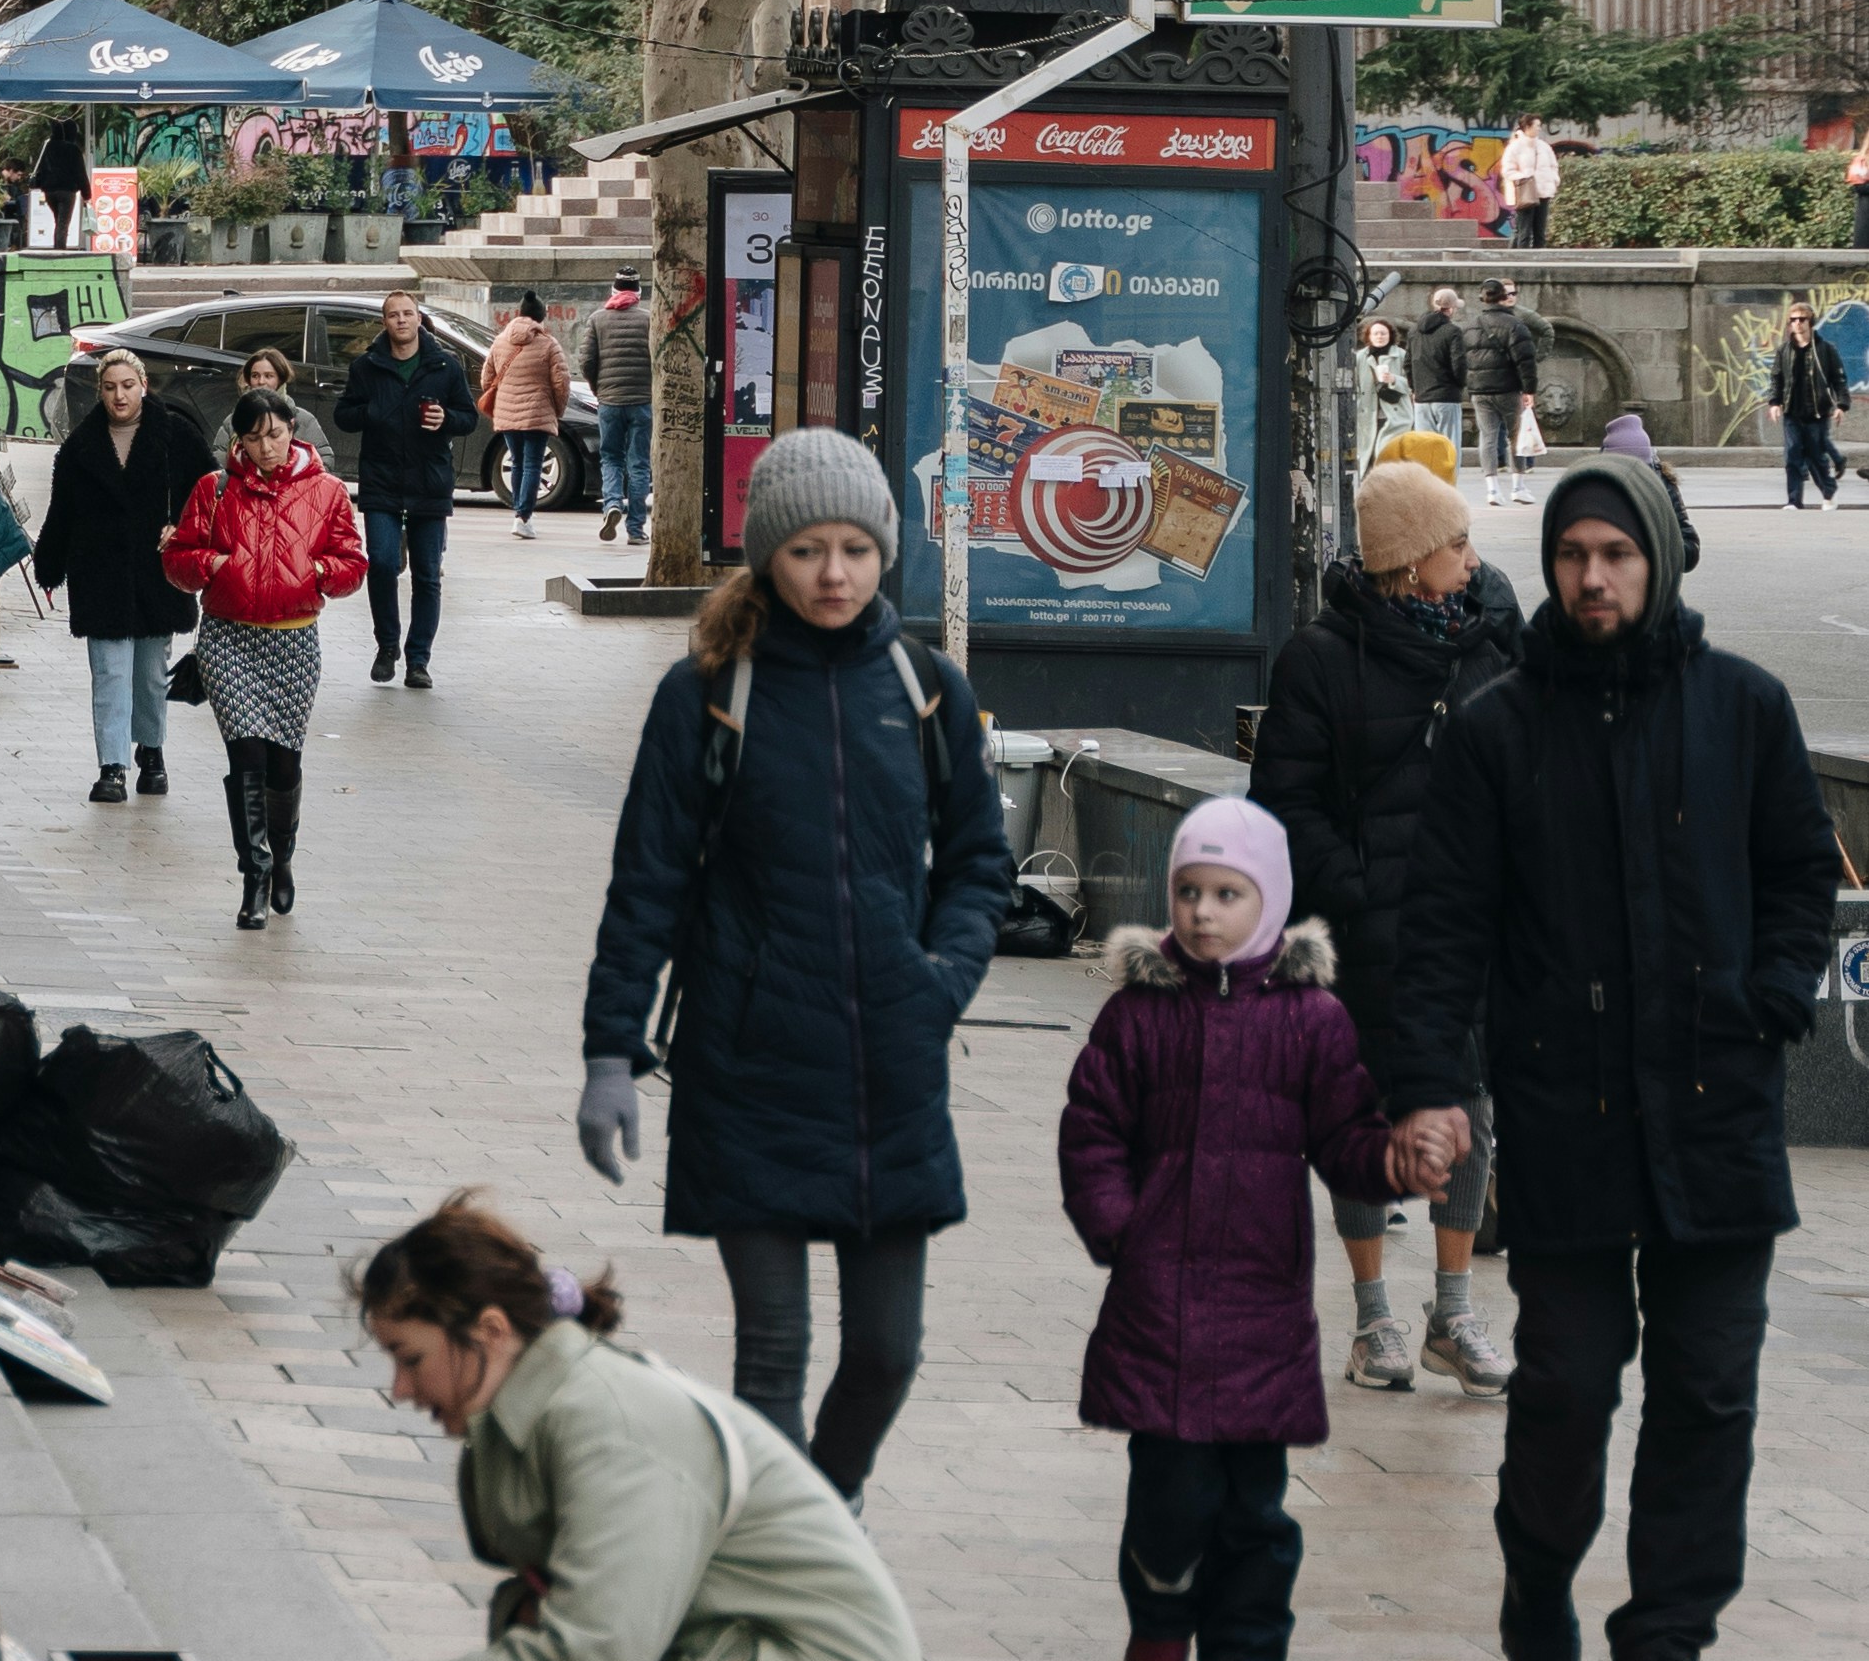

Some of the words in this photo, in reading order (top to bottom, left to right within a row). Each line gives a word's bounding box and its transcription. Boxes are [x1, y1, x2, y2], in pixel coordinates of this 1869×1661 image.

[88, 38, 169, 75] Argo
[418, 45, 483, 84] Argo
[1035, 123, 1130, 156] Coca-Cola
[752, 211, 769, 222] 30
[1061, 208, 1153, 235] lotto.ge
[746, 233, 792, 264] 3
[1129, 275, 1220, 297] თამაში
[1174, 464, 1229, 498] ფარაონი
[986, 596, 1062, 609] საქართველოს
[1063, 599, 1120, 610] ეროვნული
[1122, 601, 1171, 612] ლატარია
[1030, 610, 1070, 623] lotto.ge
[1082, 614, 1099, 622] 200
[1101, 614, 1112, 622] 77
[1114, 614, 1126, 623] 00
